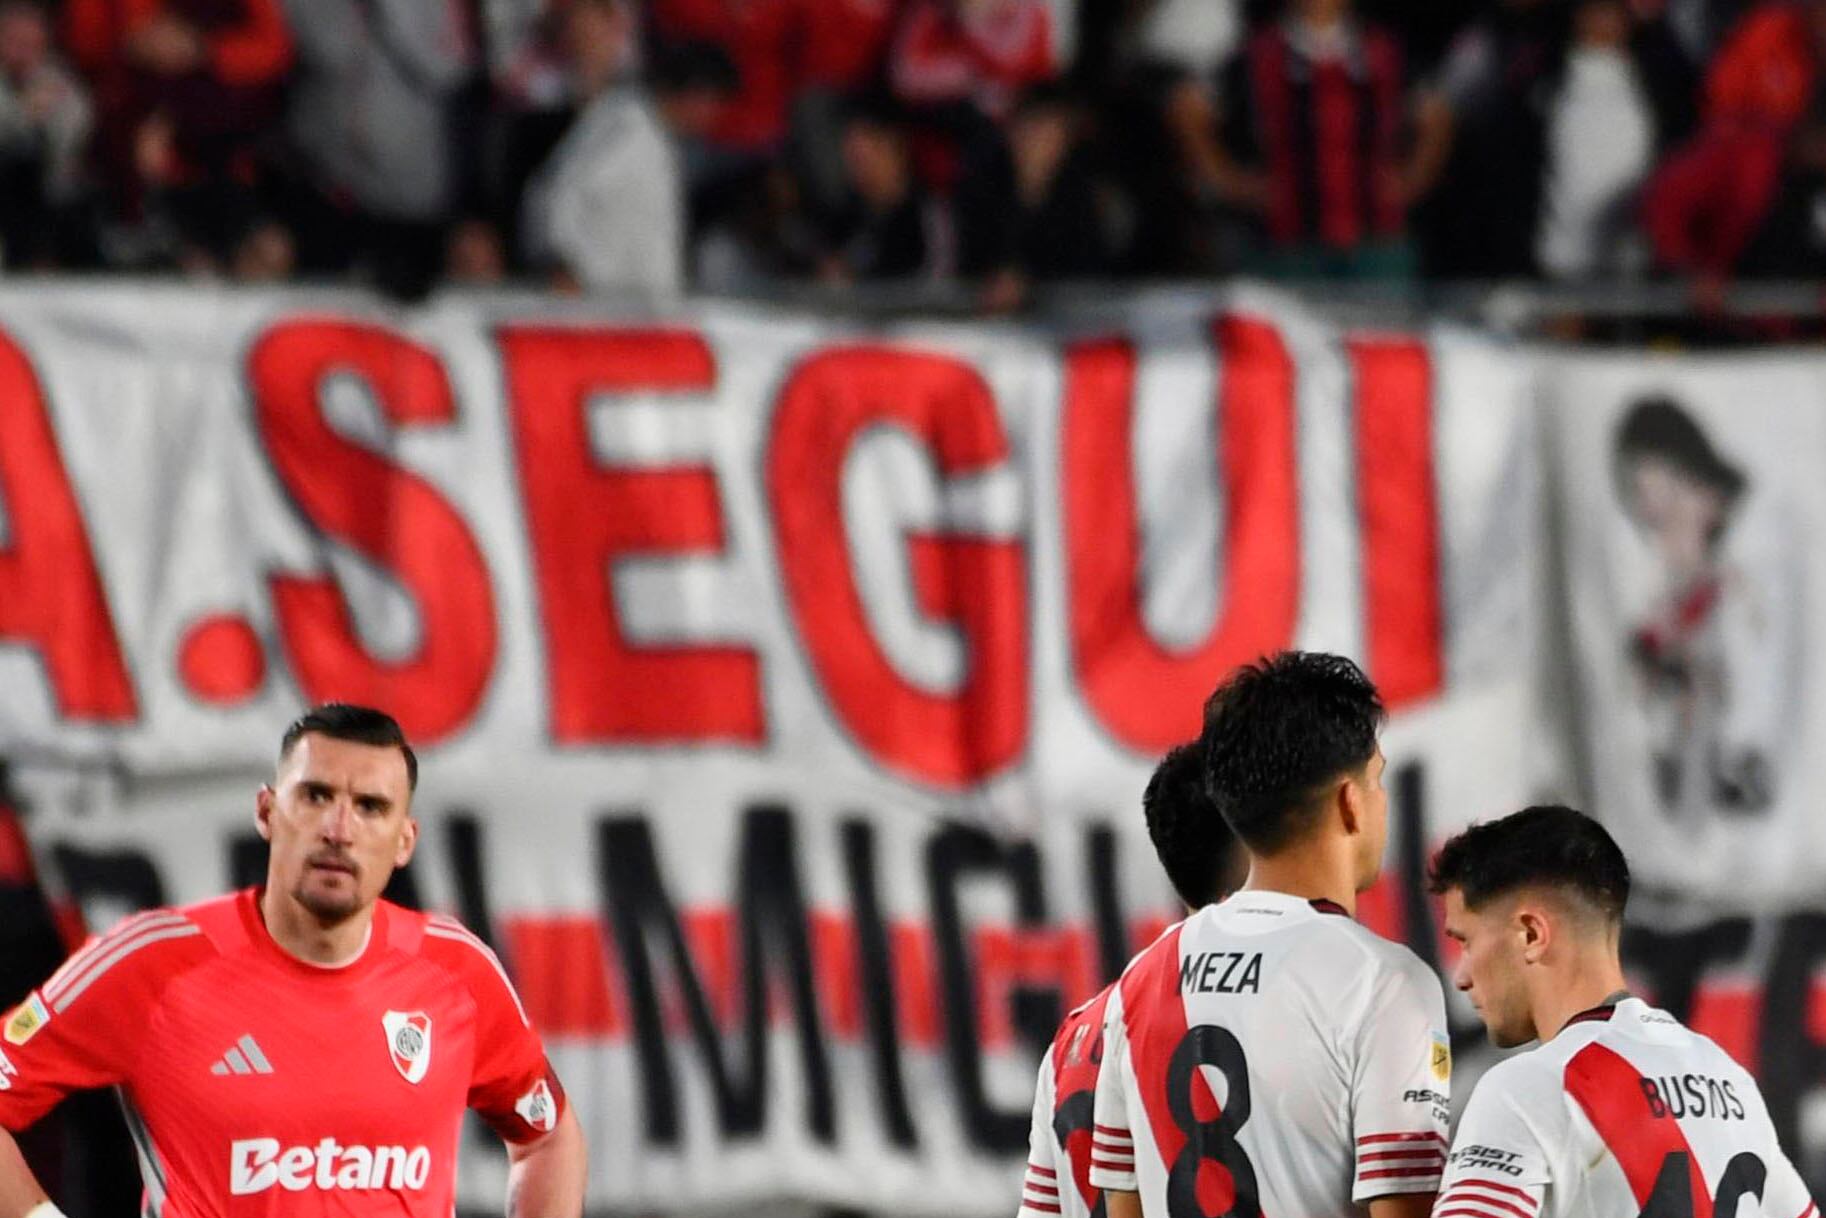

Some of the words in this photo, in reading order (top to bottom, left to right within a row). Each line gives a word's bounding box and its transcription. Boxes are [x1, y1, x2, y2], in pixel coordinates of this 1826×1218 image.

[1180, 951, 1264, 996] MEZA
[1638, 1073, 1747, 1122] BUSTOS
[230, 1136, 431, 1195] Betano
